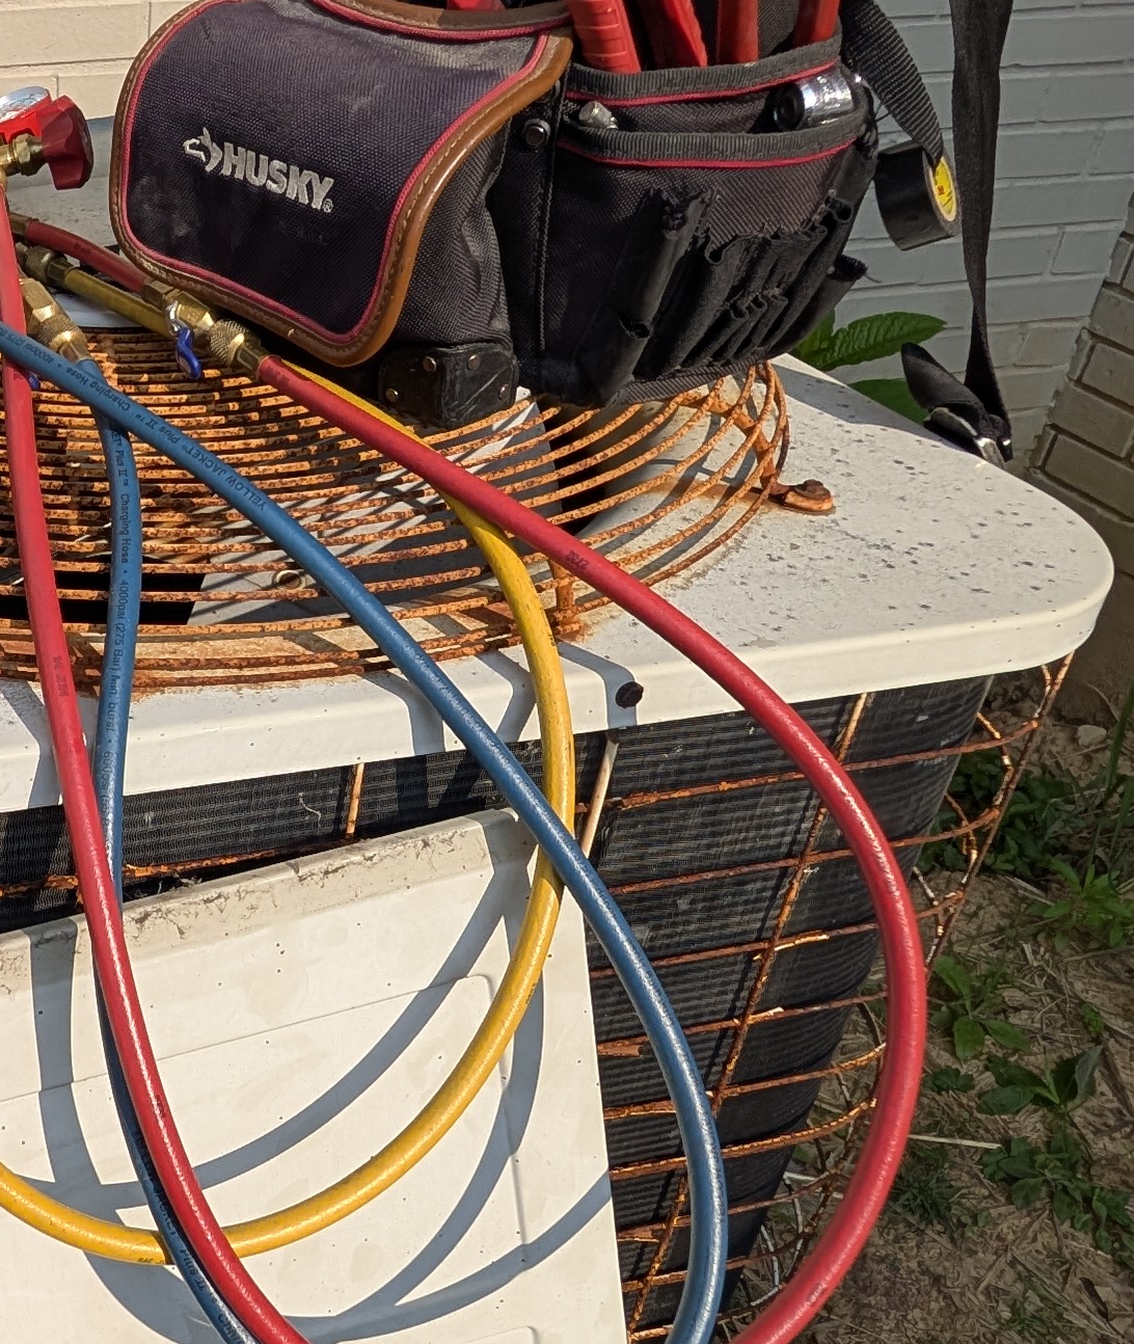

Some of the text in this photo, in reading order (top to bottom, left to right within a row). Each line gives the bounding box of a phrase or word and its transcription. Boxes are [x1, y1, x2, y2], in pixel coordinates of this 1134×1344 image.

[66, 367, 89, 386] Hose
[89, 381, 131, 411] Charging
[158, 425, 181, 444] Plus
[114, 450, 125, 467] Plus
[225, 475, 266, 511] YELLOW
[120, 493, 131, 536] Charging
[121, 538, 132, 564] Hose
[116, 580, 130, 622] 4000psi
[114, 622, 127, 646] (275
[109, 648, 124, 671] Bar)
